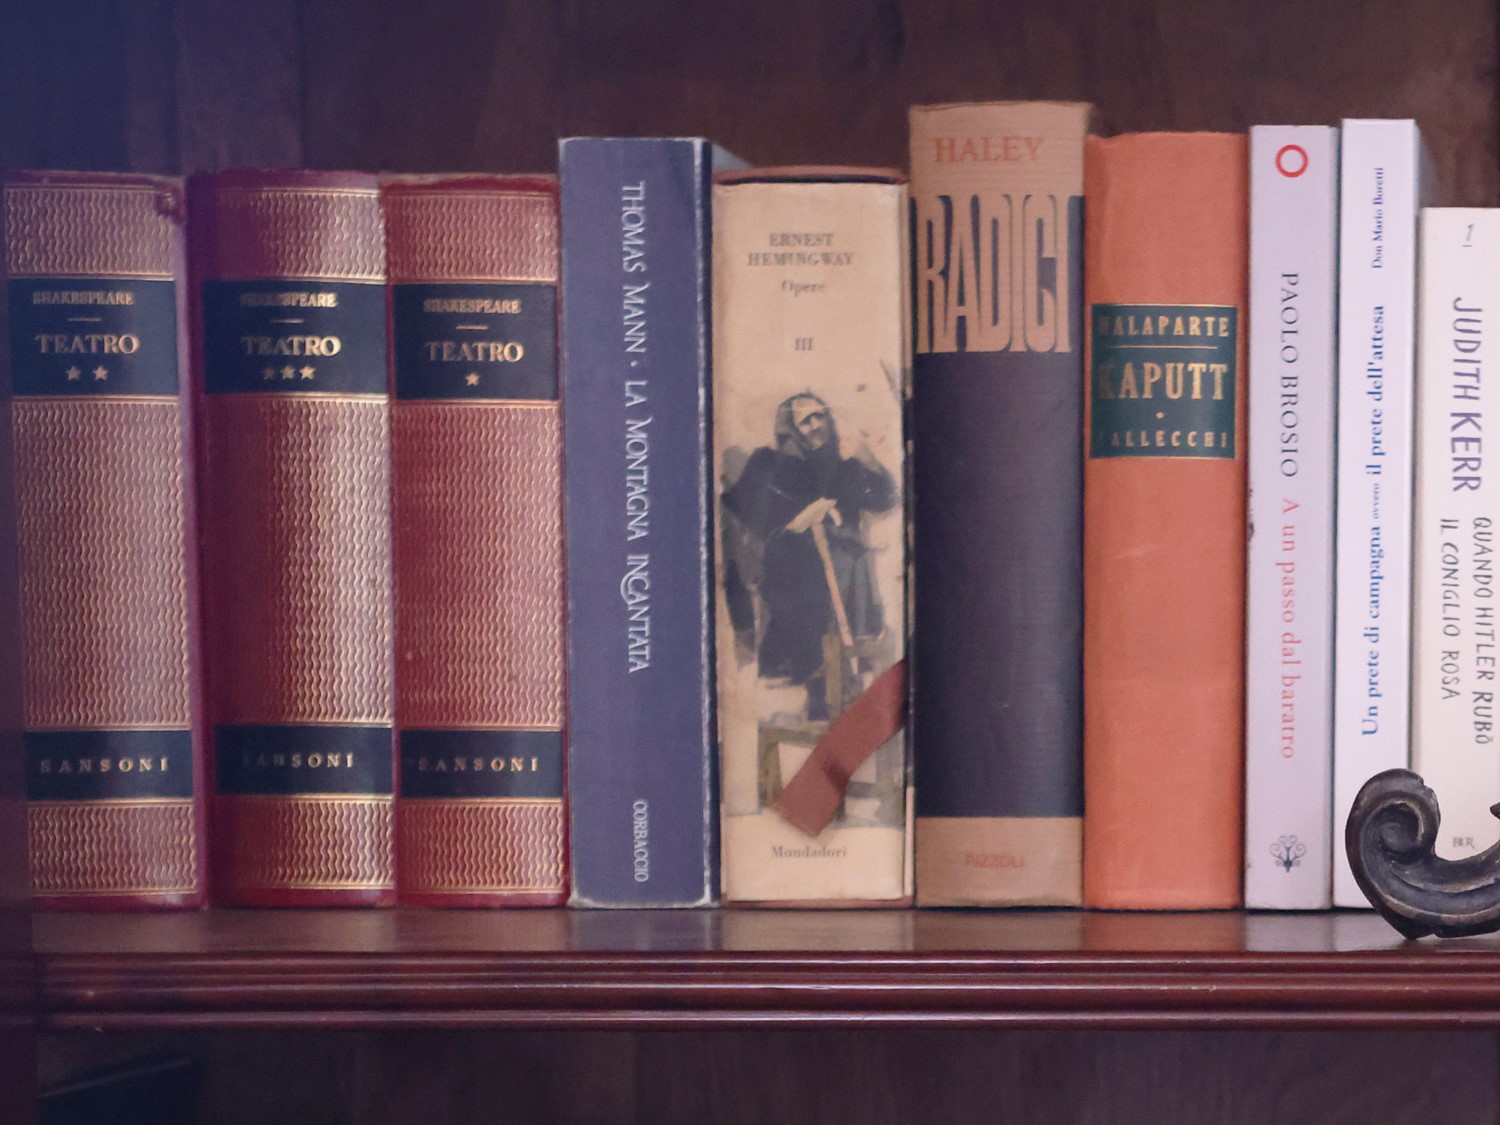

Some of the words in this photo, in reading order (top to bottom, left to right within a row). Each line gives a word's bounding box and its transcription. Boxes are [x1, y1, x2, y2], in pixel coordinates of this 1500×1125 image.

[934, 136, 1046, 163] HALEY
[621, 180, 647, 274] THOMAS
[768, 232, 834, 247] ERNEST
[1372, 208, 1383, 241] Mario
[747, 251, 854, 267] HEMINGWAY
[1372, 245, 1383, 269] Don
[781, 277, 826, 297] Opere
[623, 282, 651, 353] MANN
[1281, 272, 1299, 365] PAOLO
[35, 334, 141, 355] TEATRO
[241, 334, 342, 358] TEATRO
[423, 341, 525, 363] TEATRO
[1366, 305, 1385, 402] dell'attesa
[1452, 296, 1483, 401] JUDITH
[625, 380, 648, 408] LA
[1098, 361, 1229, 400] KAPUTT
[1108, 431, 1228, 449] ALLECCHI
[1281, 374, 1299, 477] BROSIO
[1370, 408, 1386, 457] prete
[1366, 463, 1382, 475] il
[1450, 411, 1483, 492] KERR
[625, 416, 653, 541] MONTAGNA
[1282, 497, 1300, 515] A
[1372, 482, 1381, 520] ovvero
[1282, 524, 1296, 552] un
[1440, 518, 1460, 536] IL
[1369, 525, 1384, 619] campagna
[1471, 516, 1494, 599] QUANDO
[1276, 561, 1296, 624] passo
[1440, 542, 1462, 638] CONIGLIO
[620, 553, 651, 674] INCANTATA
[1282, 631, 1301, 665] dal
[1363, 626, 1380, 643] di
[1474, 605, 1495, 682] HITLER
[1368, 650, 1382, 699] prete
[1440, 650, 1461, 701] ROSA
[1281, 673, 1301, 759] baratro
[1362, 705, 1379, 736] Un
[39, 756, 170, 774] SANSONI
[417, 755, 540, 774] SANSONI
[633, 800, 649, 883] CORBACCIO
[771, 845, 848, 859] Mondadori
